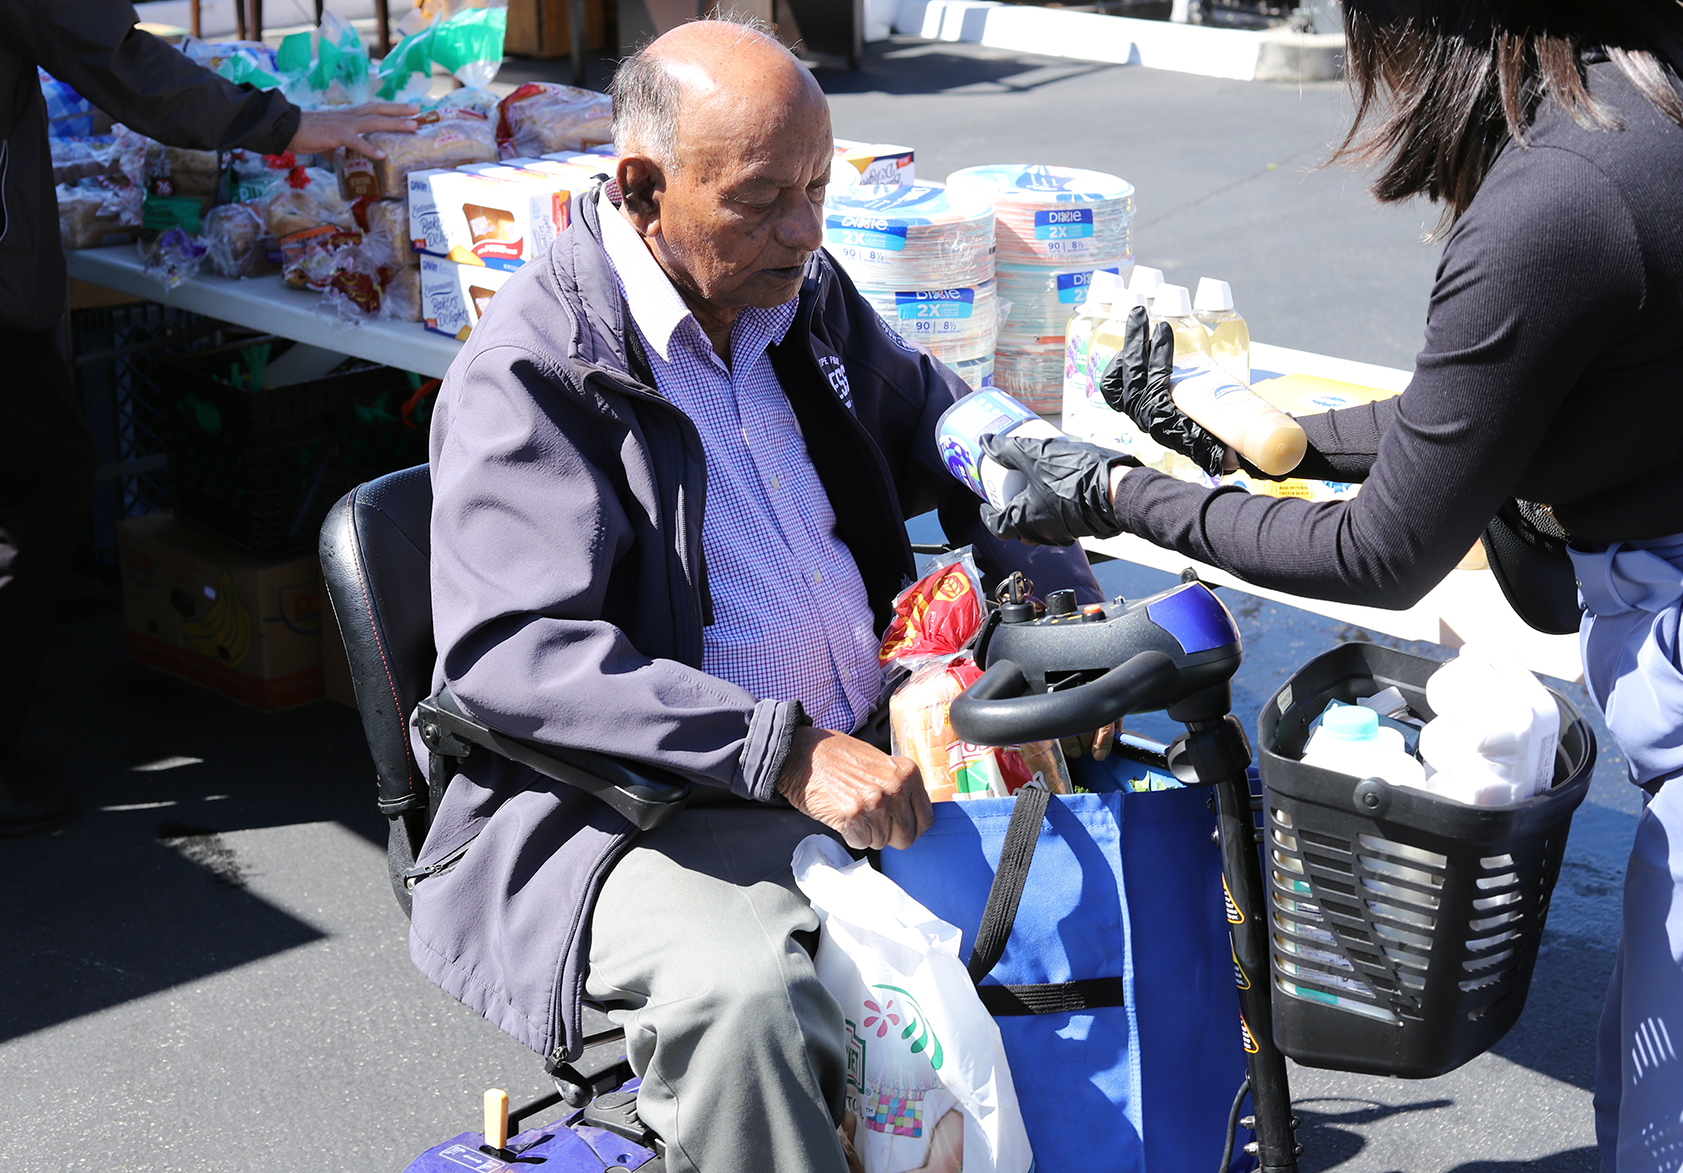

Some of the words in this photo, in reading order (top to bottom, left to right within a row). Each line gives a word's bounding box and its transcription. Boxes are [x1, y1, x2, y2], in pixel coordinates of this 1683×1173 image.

[1049, 226, 1068, 238] 2X
[841, 230, 866, 246] 2X
[1048, 242, 1060, 250] 90
[842, 247, 856, 257] 90
[917, 303, 941, 317] 2X
[916, 321, 930, 330] 90
